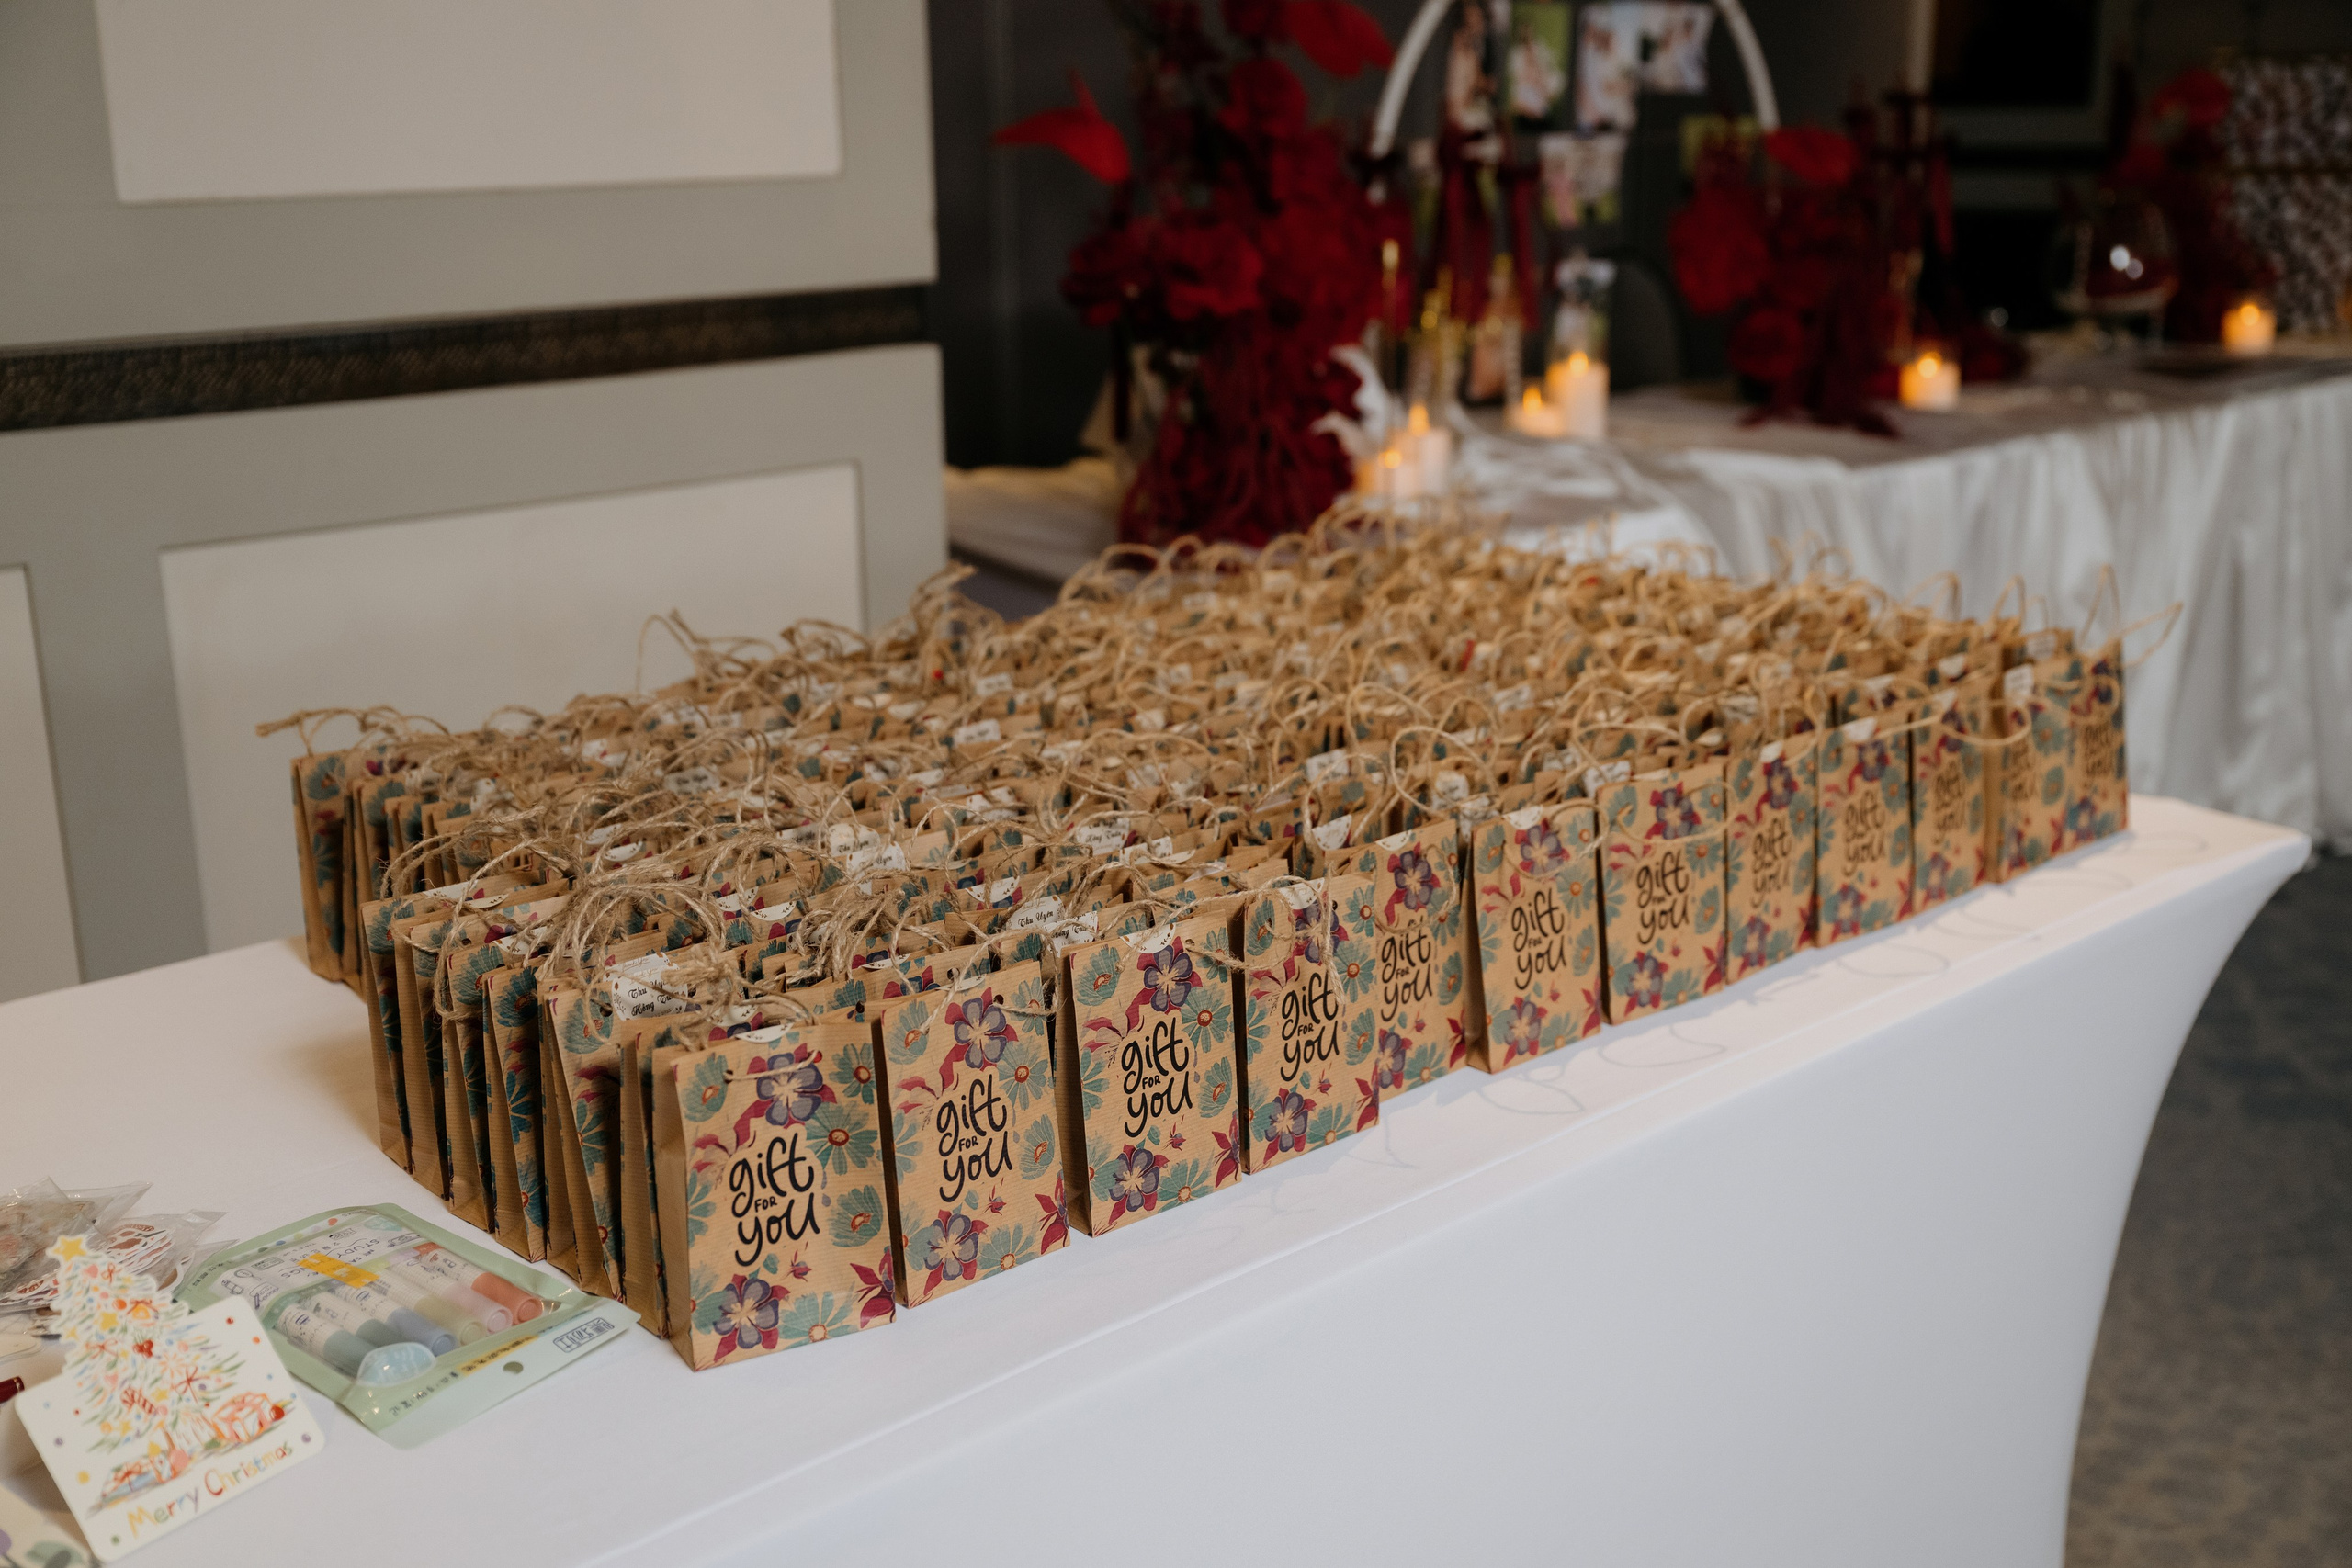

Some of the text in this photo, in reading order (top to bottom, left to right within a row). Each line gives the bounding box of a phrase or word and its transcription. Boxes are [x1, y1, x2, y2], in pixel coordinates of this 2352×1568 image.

[1845, 789, 1885, 842] gift
[1753, 818, 1791, 873] gift
[1841, 837, 1885, 877] you
[1637, 849, 1690, 908] gift
[1750, 863, 1791, 908] you
[1017, 916, 1034, 927] Thu
[1511, 887, 1565, 952] gift
[1637, 894, 1690, 945] you
[1382, 915, 1431, 983] gift
[1396, 966, 1410, 979] FOR
[1515, 935, 1567, 990] you
[628, 987, 648, 999] Thu
[1282, 970, 1339, 1041] gift
[1381, 964, 1433, 1022] you
[1121, 1017, 1190, 1094] gift
[1280, 1021, 1340, 1082] you
[1297, 1022, 1314, 1036] FOR
[1124, 1071, 1193, 1138] you
[1142, 1075, 1161, 1090] FOR
[936, 1074, 1008, 1157] gift
[939, 1131, 1012, 1202] you
[959, 1135, 979, 1152] FOR
[729, 1133, 815, 1218] gift
[734, 1192, 820, 1267] you
[754, 1196, 778, 1213] FOR
[336, 1238, 379, 1258] STUDY
[127, 1441, 293, 1539] Merry Christmas
